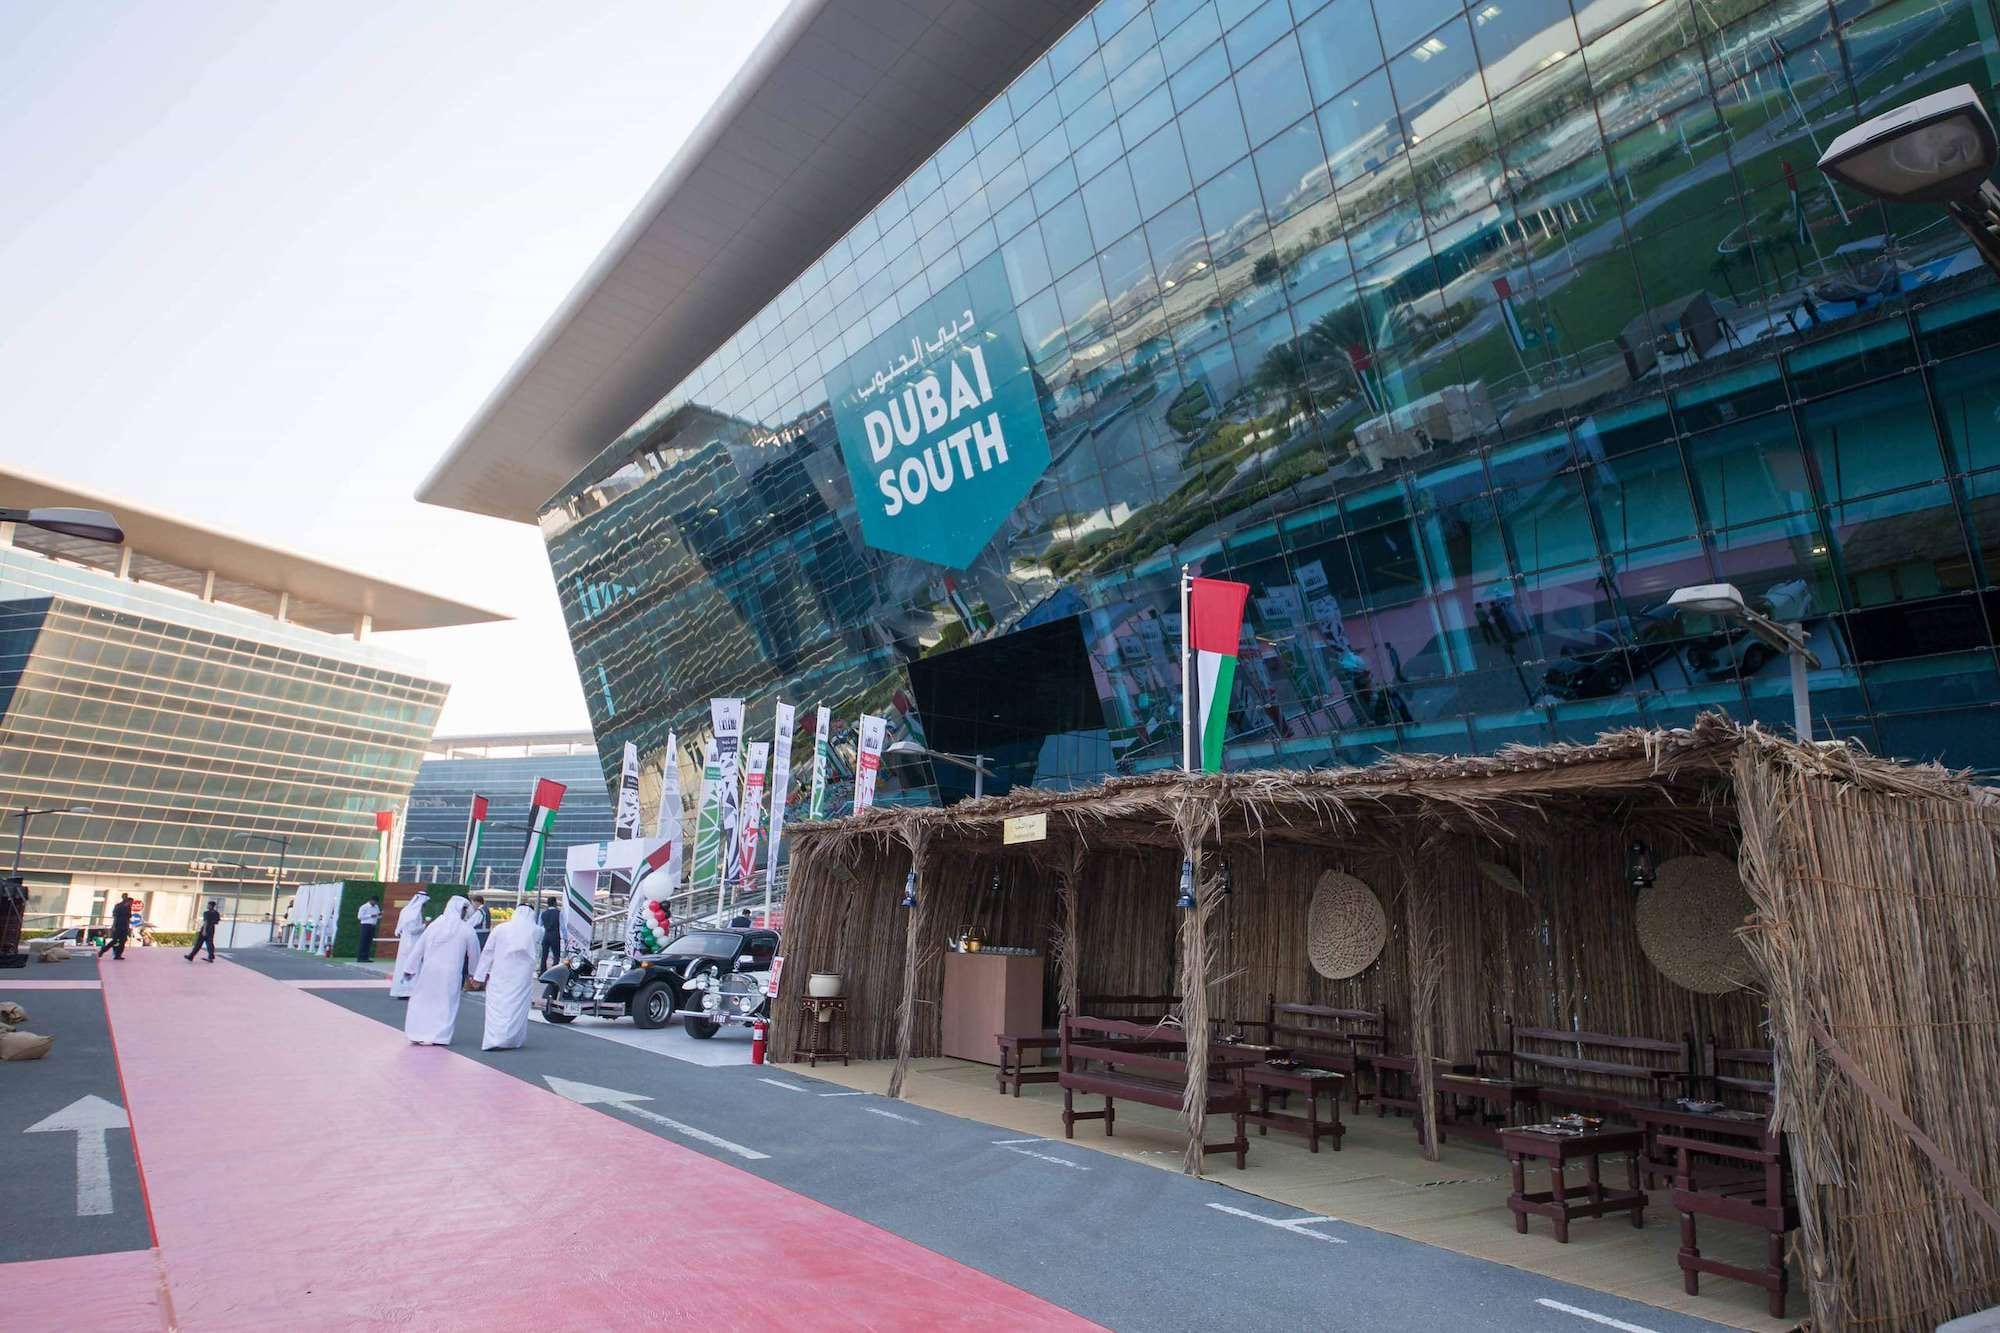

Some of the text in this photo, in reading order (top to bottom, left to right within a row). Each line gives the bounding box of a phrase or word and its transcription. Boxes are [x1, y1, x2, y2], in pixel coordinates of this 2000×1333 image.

[857, 309, 975, 399] دبي الجنوب
[864, 345, 993, 463] DUBAI
[879, 412, 1008, 516] SOUTH
